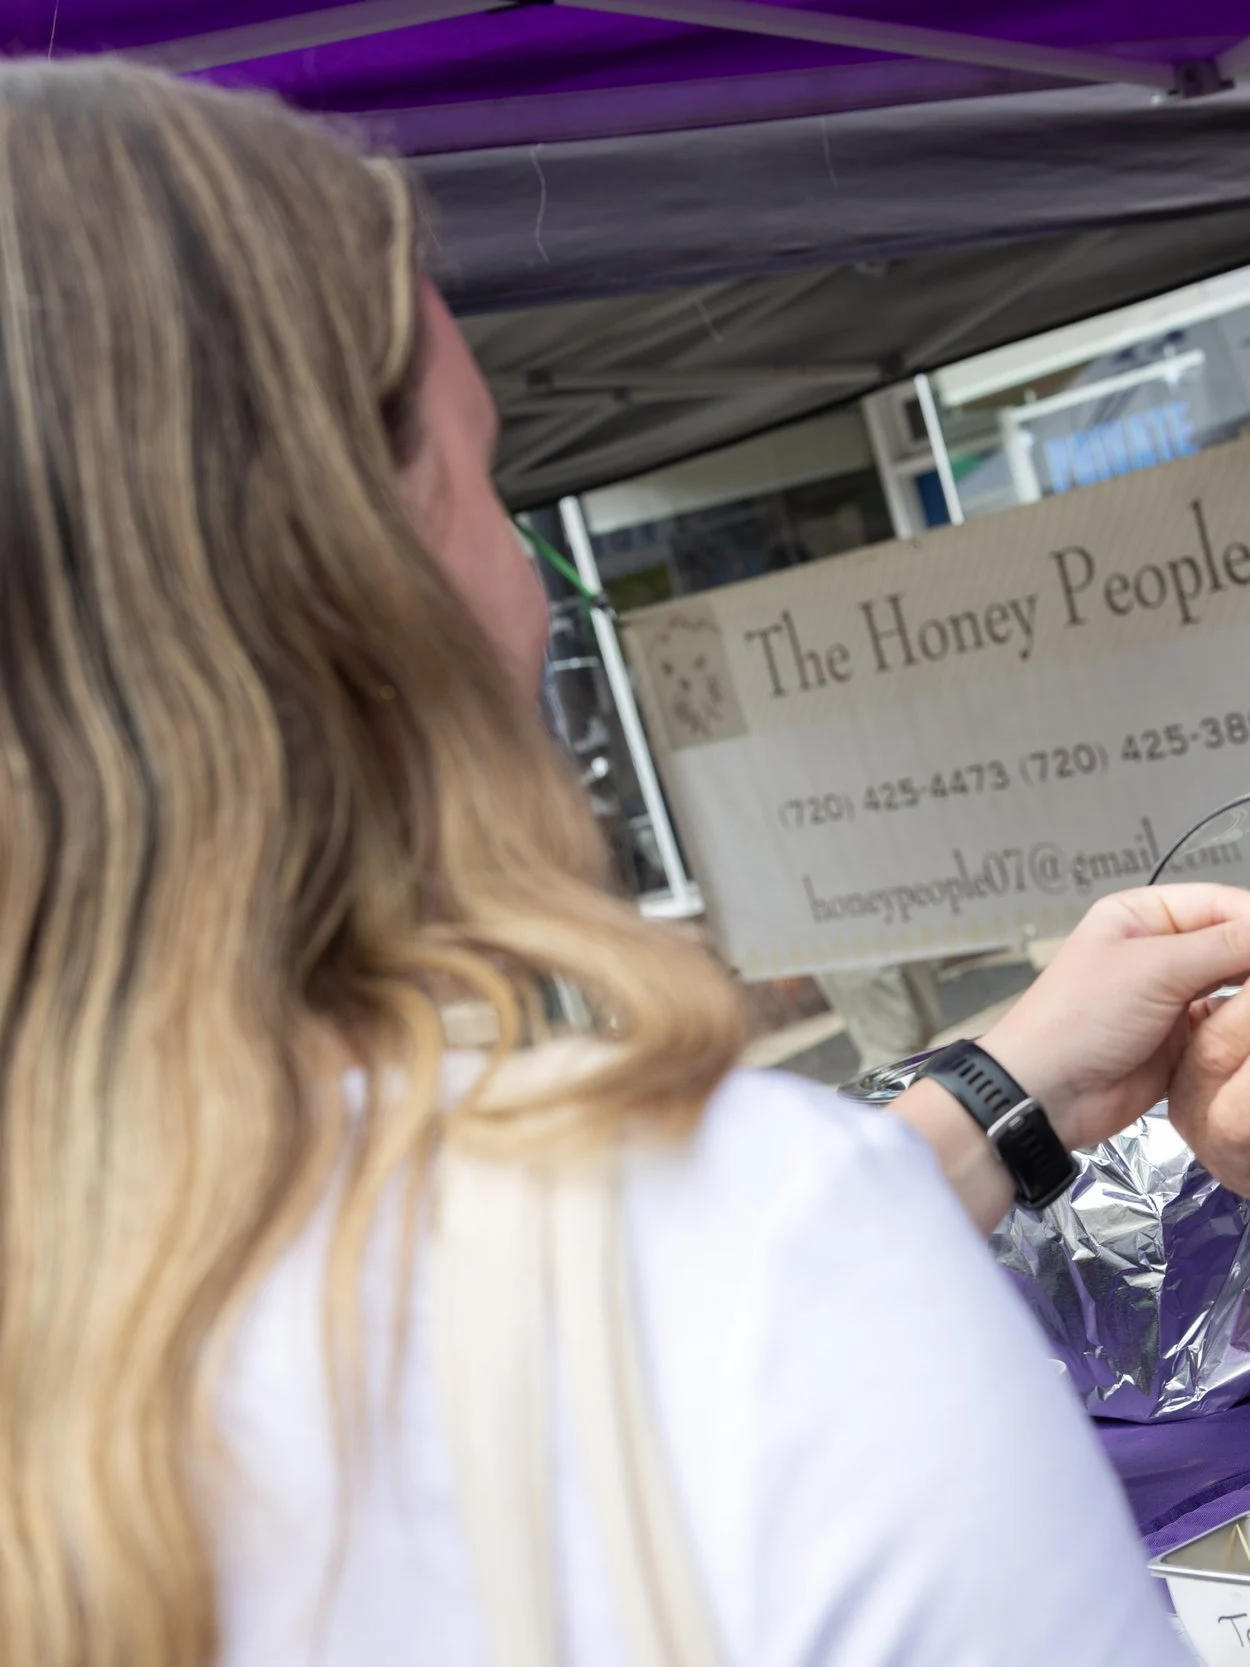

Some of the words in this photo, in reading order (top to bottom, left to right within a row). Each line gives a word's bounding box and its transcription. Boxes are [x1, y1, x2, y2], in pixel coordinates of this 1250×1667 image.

[744, 610, 854, 699] The
[858, 593, 1038, 672] Honey
[779, 790, 856, 830] (720)
[862, 758, 1011, 813] 425-4473
[1018, 740, 1110, 787] (720)
